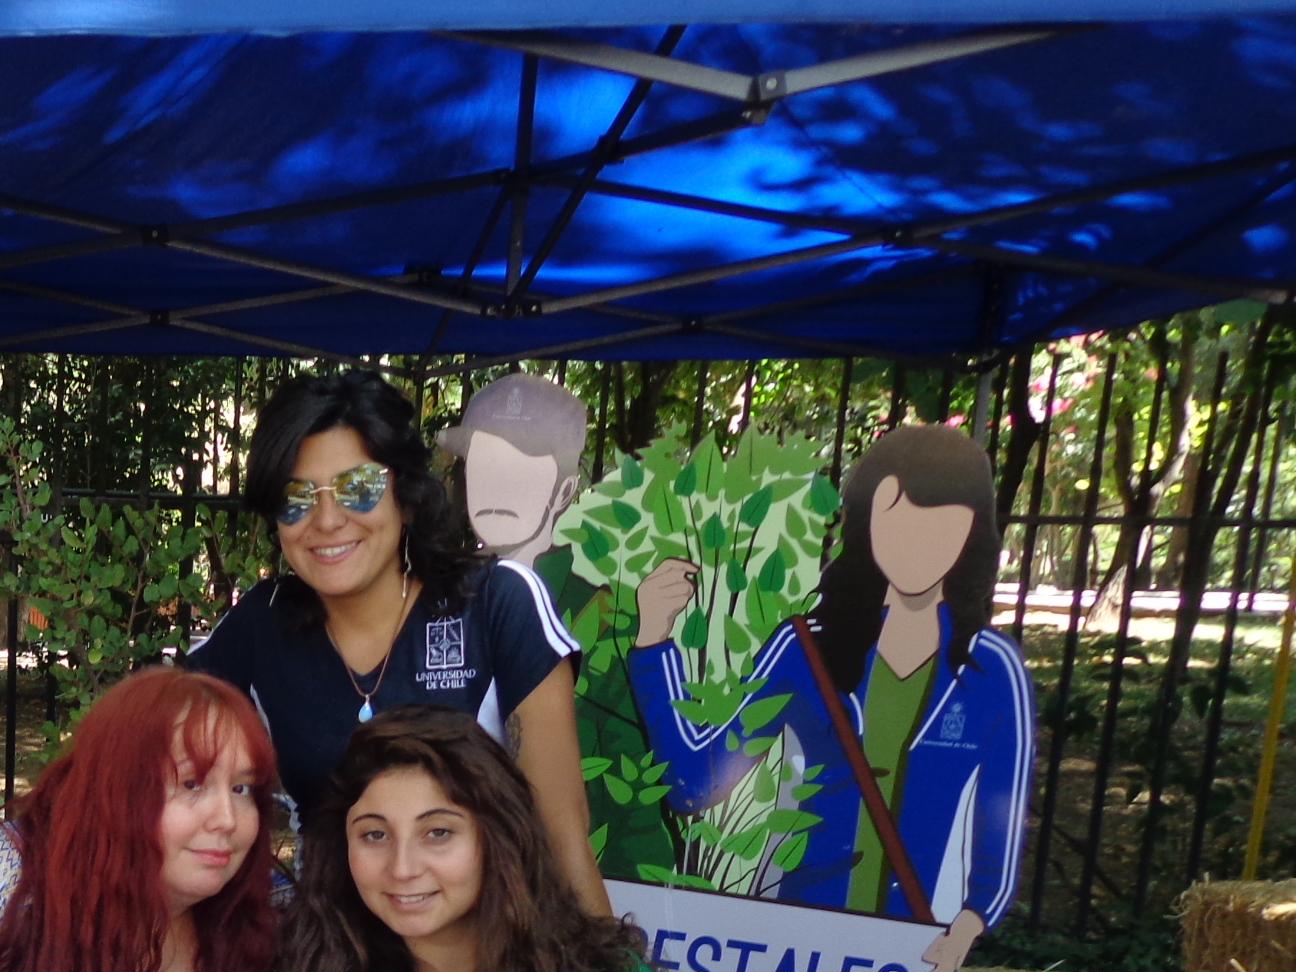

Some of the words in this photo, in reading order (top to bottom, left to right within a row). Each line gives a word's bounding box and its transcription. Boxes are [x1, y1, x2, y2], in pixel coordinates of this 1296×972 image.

[415, 668, 477, 683] UNIVERSIDAD
[426, 680, 438, 691] DE
[440, 678, 467, 690] CHILE
